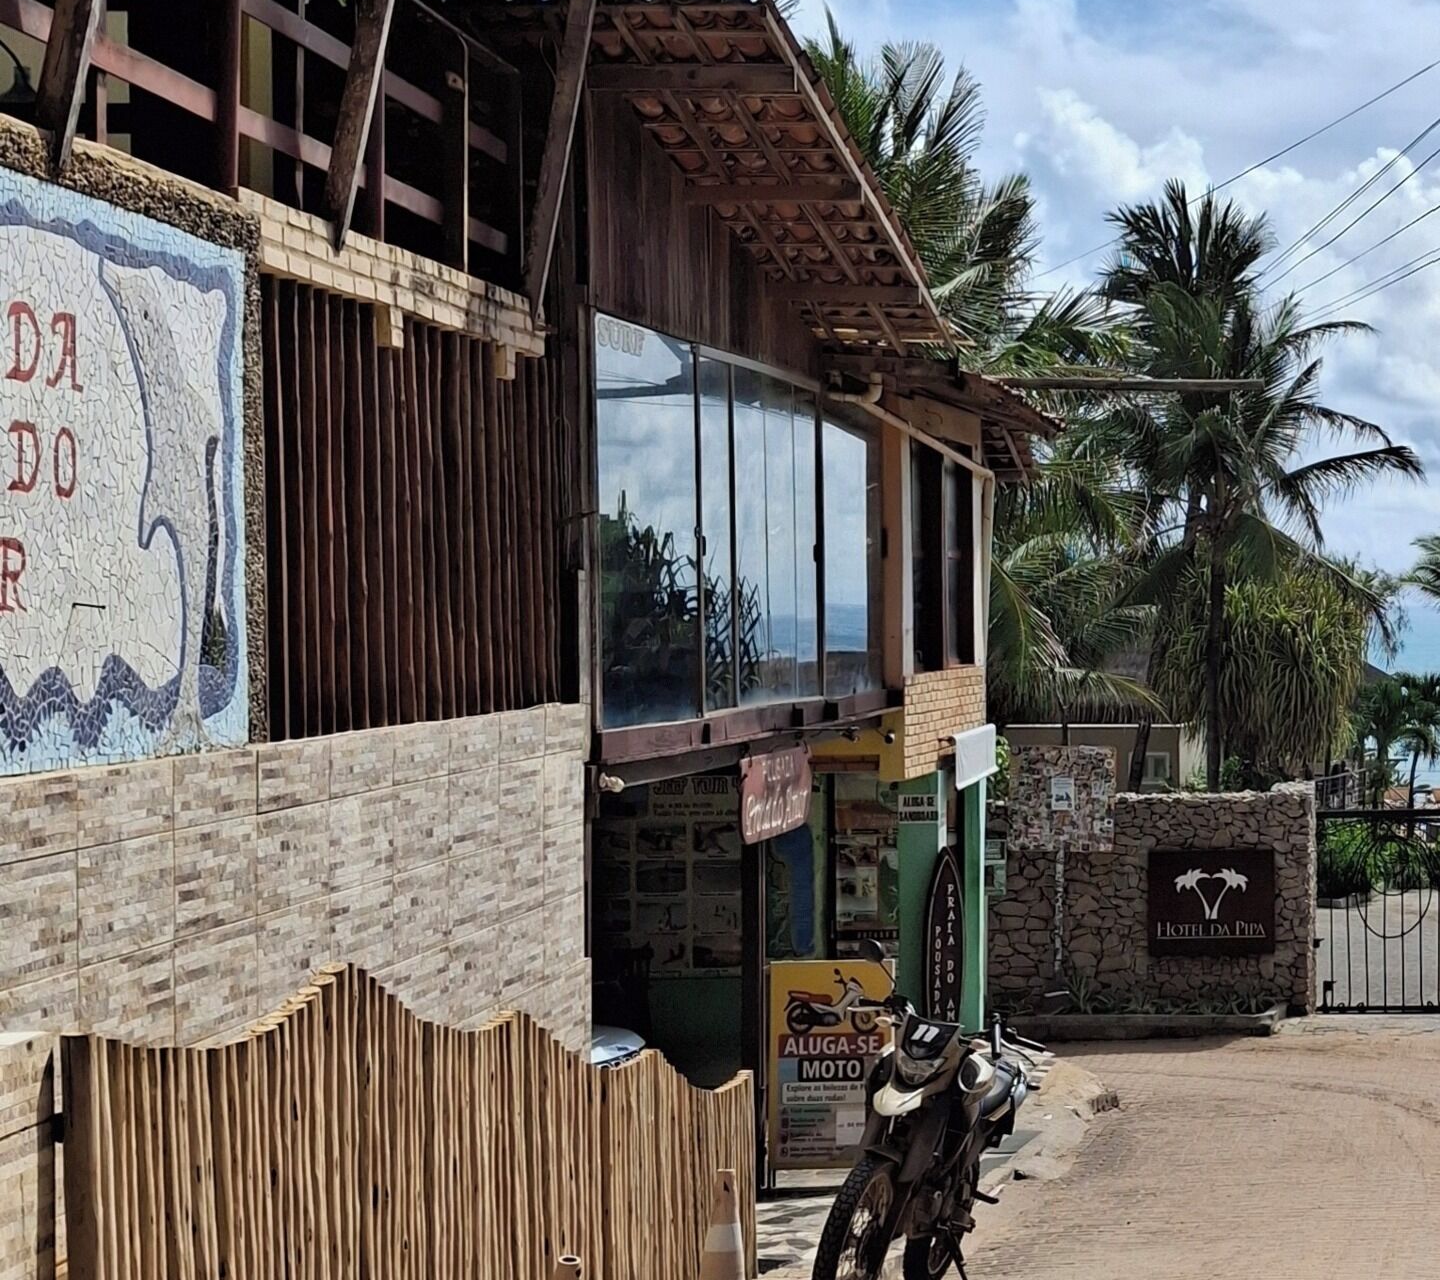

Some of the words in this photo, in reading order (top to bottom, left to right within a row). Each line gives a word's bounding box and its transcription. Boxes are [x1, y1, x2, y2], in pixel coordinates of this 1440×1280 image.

[598, 317, 645, 357] SURF
[7, 422, 76, 498] DO
[947, 883, 956, 946] PRAIA
[1157, 921, 1203, 937] HOTEL
[1236, 920, 1266, 936] PIPA
[934, 925, 942, 1015] POUSADA
[947, 960, 955, 984] DO
[947, 998, 956, 1022] AM
[783, 1035, 881, 1056] ALUGA-SE
[802, 1059, 862, 1080] MOTO
[786, 1084, 812, 1093] Explore
